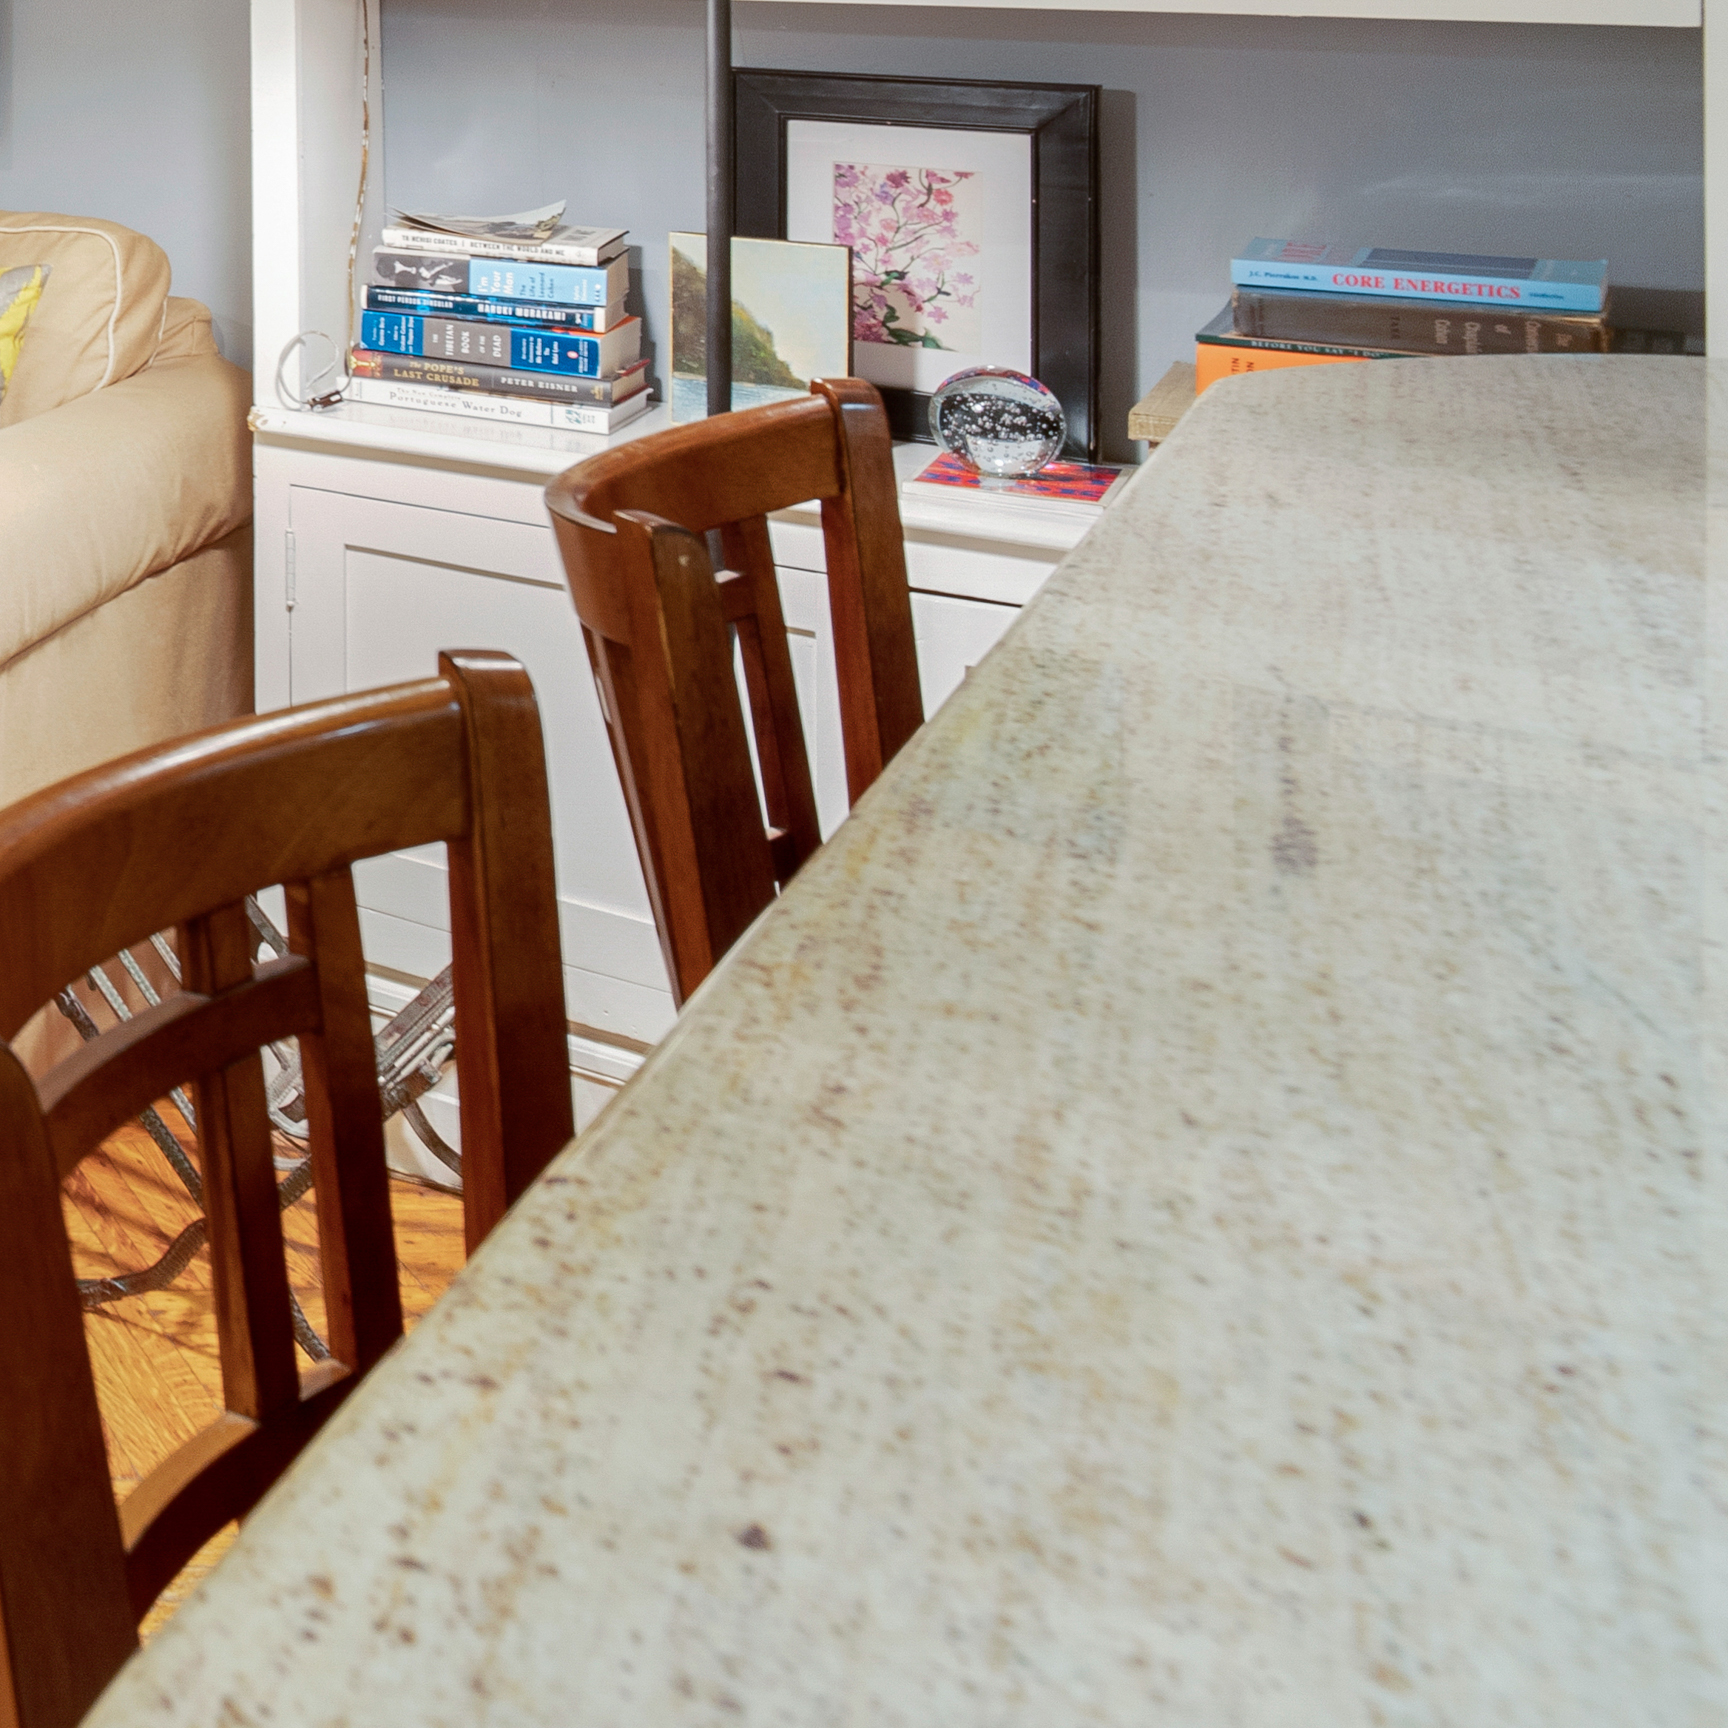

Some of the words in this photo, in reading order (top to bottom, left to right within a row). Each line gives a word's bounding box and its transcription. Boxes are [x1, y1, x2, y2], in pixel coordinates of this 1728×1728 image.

[434, 237, 457, 245] COATES
[470, 241, 500, 250] BETWEEN
[517, 245, 539, 253] WORLD
[477, 276, 488, 292] I'm
[491, 271, 501, 293] Your
[503, 273, 513, 295] Man
[1332, 272, 1385, 290] CORE
[1393, 277, 1521, 300] ENERGETICS
[478, 303, 513, 315] HARUKI
[515, 307, 566, 321] MURAKAMI
[445, 324, 454, 355] TIBETAN
[461, 331, 470, 354] BOOK
[493, 334, 501, 357] DEAD
[394, 369, 422, 379] LAST
[426, 373, 480, 386] CRUSADE
[424, 363, 465, 374] POPE'S
[501, 376, 534, 387] PETER
[538, 381, 578, 392] EISNER
[390, 392, 456, 409] Portuguese
[462, 401, 494, 413] Water
[500, 406, 523, 417] Dog
